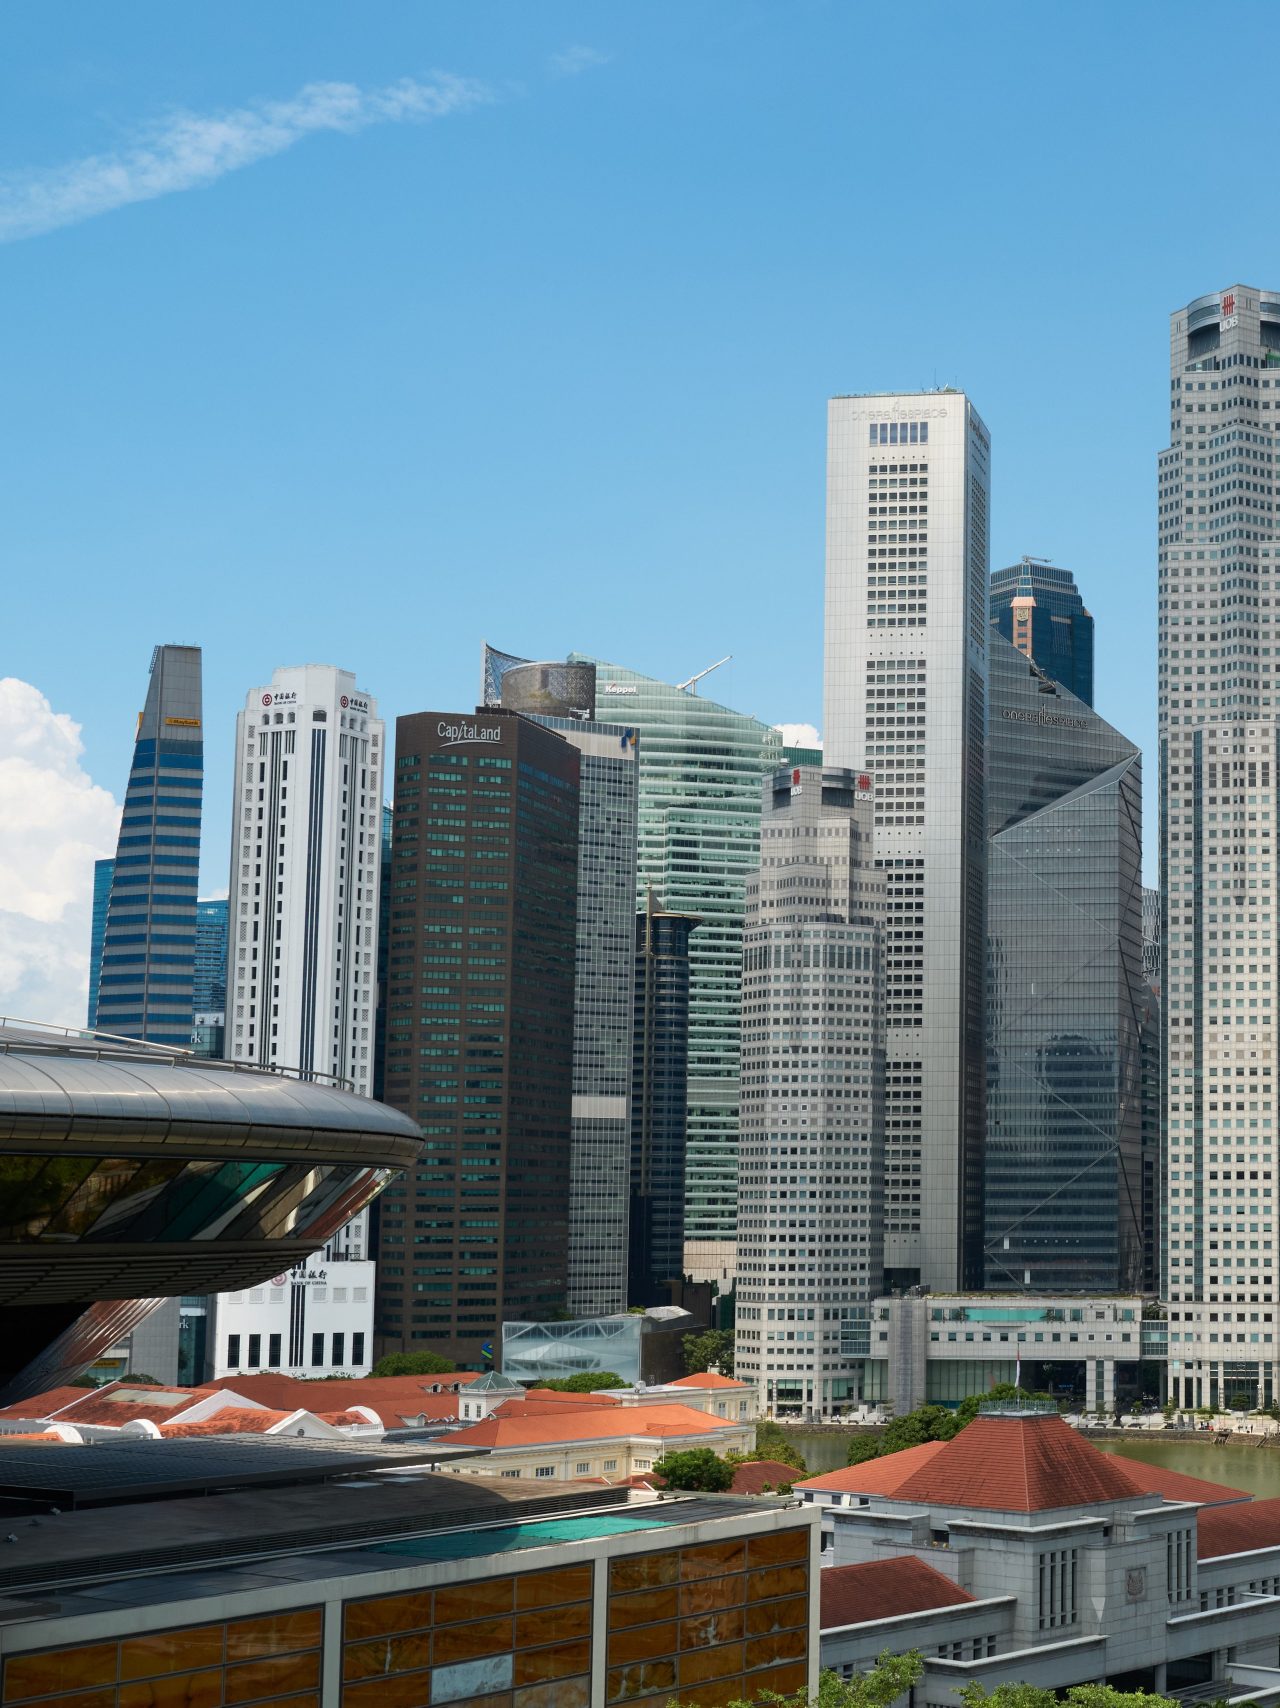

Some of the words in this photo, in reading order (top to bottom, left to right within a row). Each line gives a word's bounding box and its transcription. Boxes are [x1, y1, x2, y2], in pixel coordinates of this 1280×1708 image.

[1220, 315, 1239, 332] UOB
[605, 685, 637, 694] Keppel
[437, 720, 502, 741] CapitaLand
[791, 785, 803, 796] UOB
[855, 791, 874, 802] UOB
